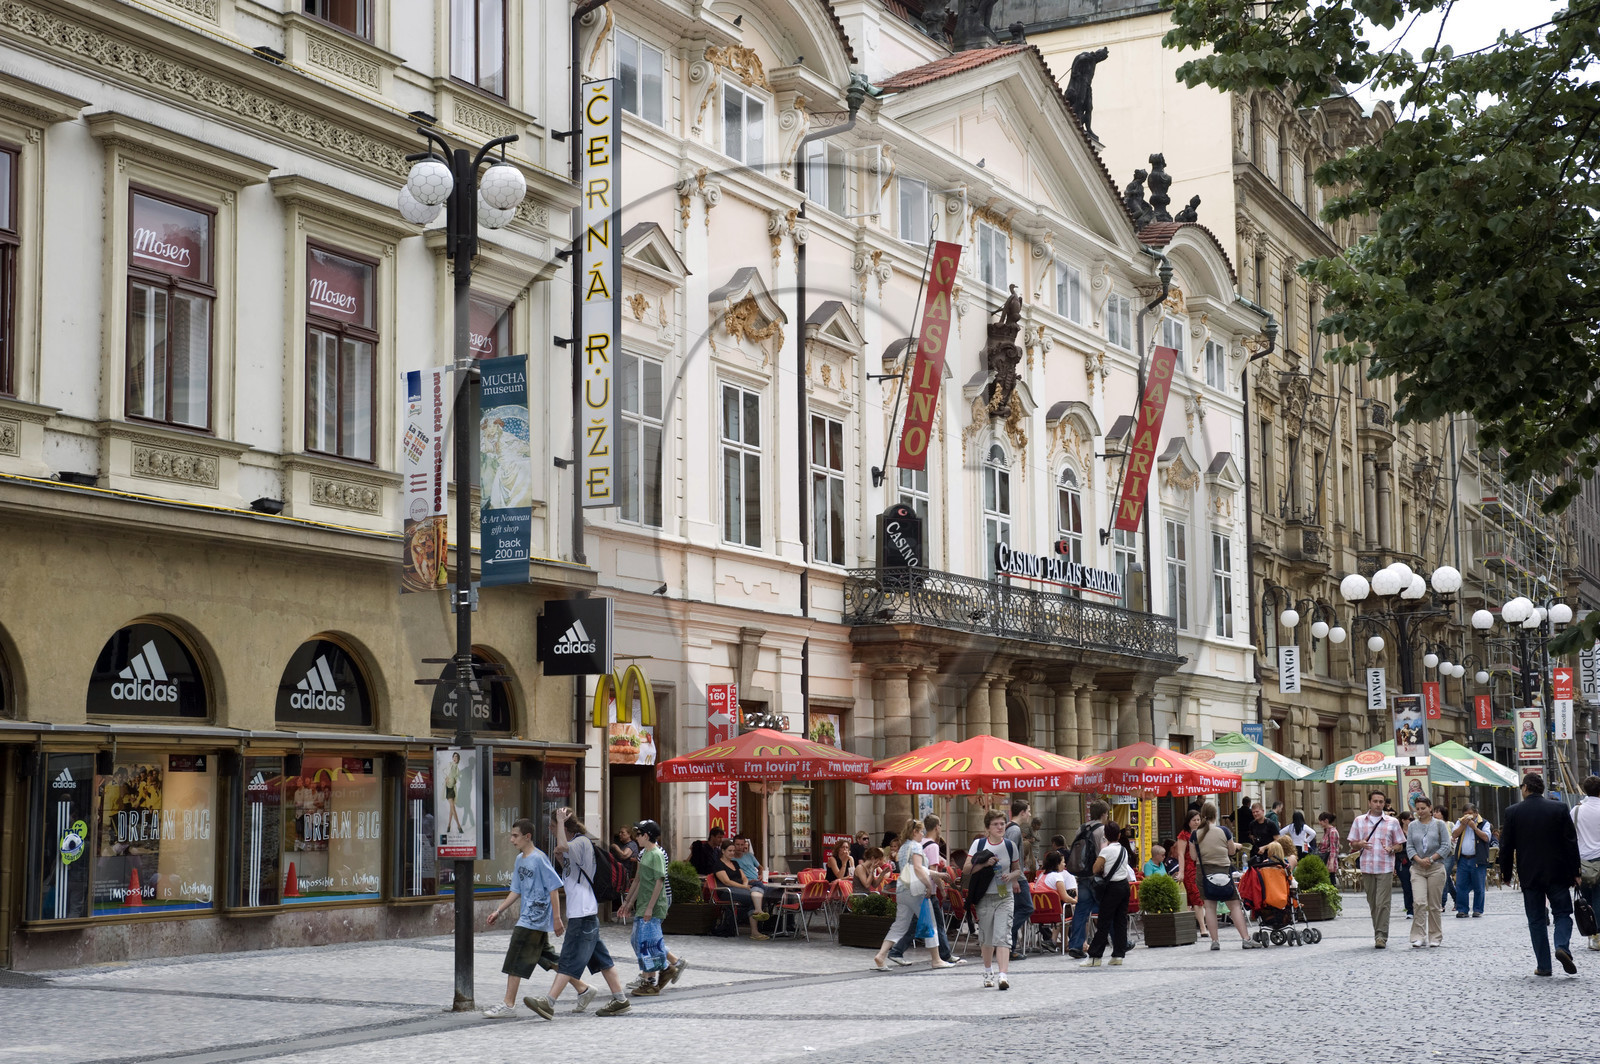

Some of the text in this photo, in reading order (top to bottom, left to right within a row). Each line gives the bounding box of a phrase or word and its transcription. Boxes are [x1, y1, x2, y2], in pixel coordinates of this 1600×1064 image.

[585, 85, 611, 301] ČERNÁ
[133, 228, 190, 264] Moser
[310, 279, 356, 311] Moser
[904, 256, 954, 456] CASINO
[482, 372, 525, 387] MUCHA
[484, 384, 524, 395] museum
[1119, 359, 1171, 521] SAVARIN
[482, 514, 530, 524] & Art Nouveau
[491, 525, 519, 536] gift shop
[499, 538, 521, 548] back
[886, 521, 919, 567] CASINO
[495, 549, 524, 559] 200 m
[999, 541, 1123, 595] CASINO PALAIS SAVARIN
[553, 643, 596, 655] adidas
[1285, 649, 1295, 691] MANGO
[111, 679, 178, 702] adidas
[709, 692, 726, 700] 160
[1372, 671, 1382, 707] MANGO
[290, 690, 346, 712] adidas
[729, 684, 737, 724] GARDEN
[673, 764, 687, 774] i'm
[689, 763, 715, 774] lovin'
[717, 762, 725, 773] it
[744, 760, 811, 772] i'm lovin' it
[828, 761, 841, 772] i'm
[842, 762, 862, 773] lovin'
[863, 763, 869, 773] it
[906, 779, 970, 790] i'm lovin' it
[992, 776, 1059, 789] i'm lovin' it
[1122, 773, 1183, 783] i'm lovin' it
[1200, 775, 1237, 788] i'm lovin' it
[117, 808, 211, 842] DREAM BIG
[303, 810, 380, 842] DREAM BIG
